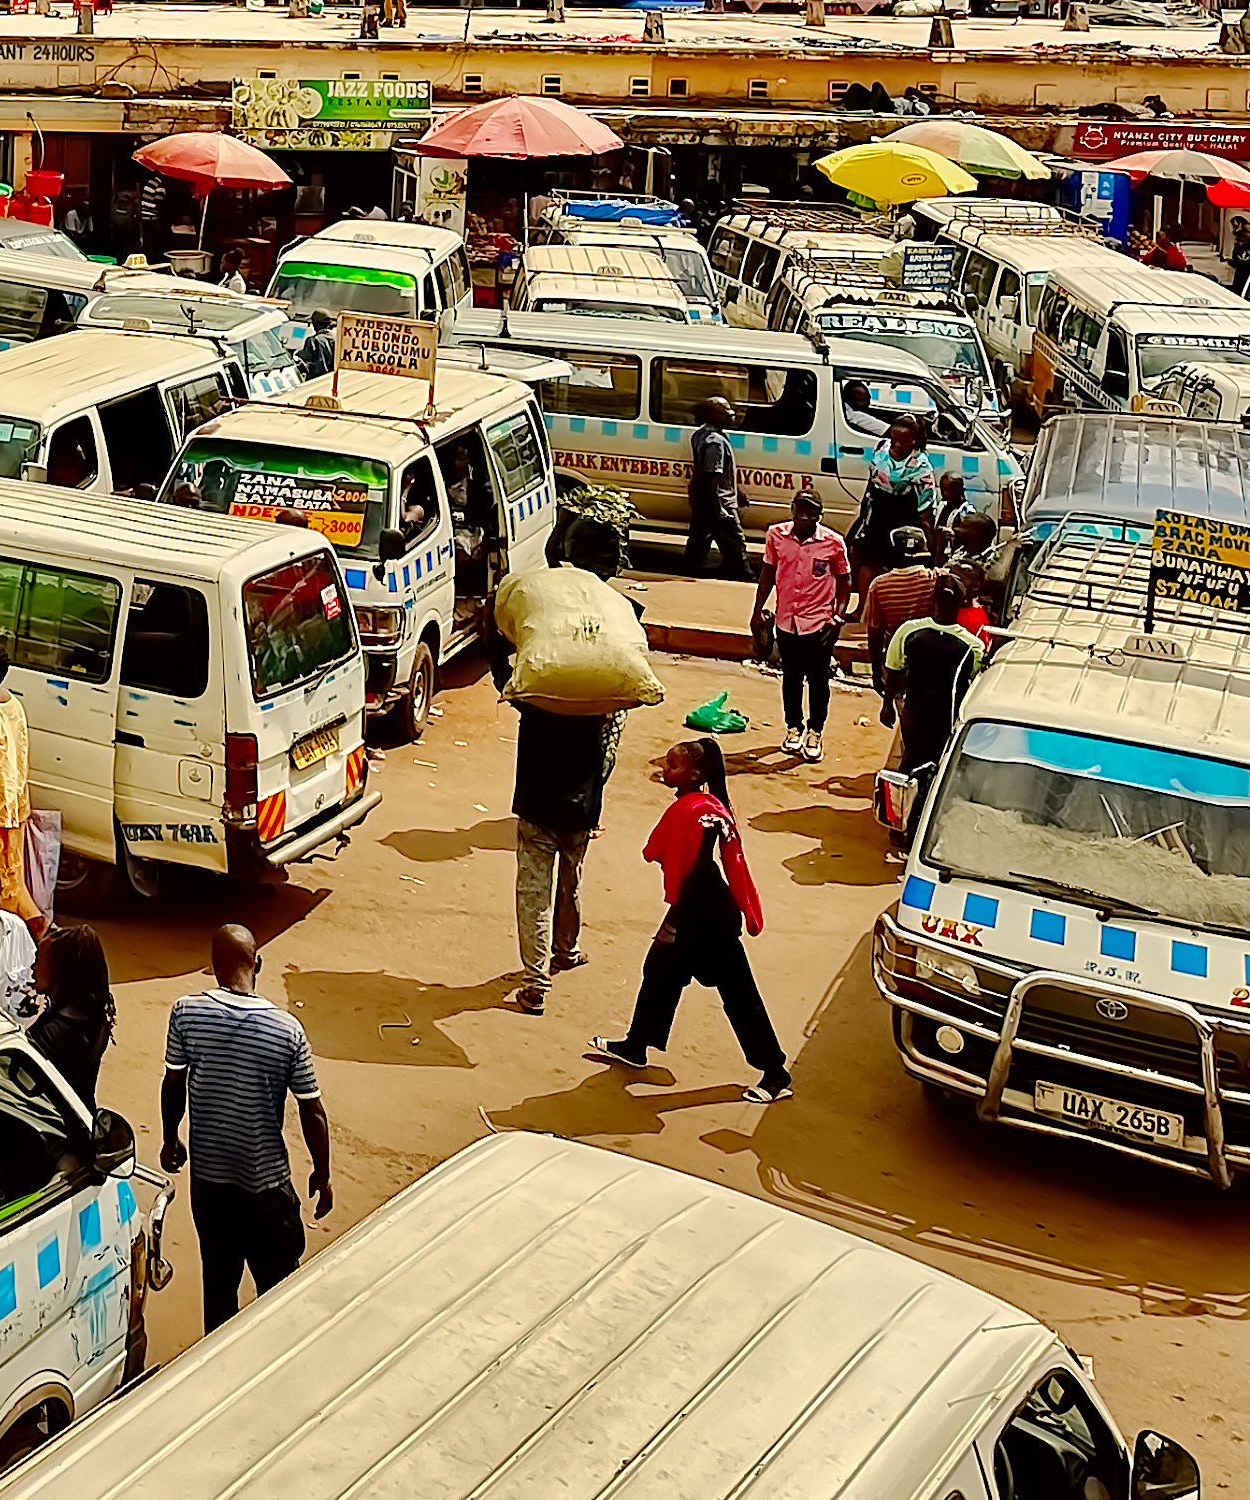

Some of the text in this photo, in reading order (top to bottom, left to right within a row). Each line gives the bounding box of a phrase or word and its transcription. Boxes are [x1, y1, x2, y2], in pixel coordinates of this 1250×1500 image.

[33, 46, 95, 62] 24HOURS
[327, 81, 429, 99] JAZZ FOODS
[329, 99, 424, 107] RESTAURANT
[1113, 131, 1247, 143] NYANZI CITY BUTCHERY
[883, 291, 907, 301] TAXI
[355, 319, 413, 335] NDEJJE
[821, 314, 962, 338] REALISM
[343, 326, 420, 346] KYADONDO
[341, 348, 418, 370] KAKOOLA
[1149, 403, 1177, 413] TAXI
[554, 450, 597, 470] PARK
[599, 455, 669, 477] ENTEBBE
[240, 473, 297, 488] ZANA
[233, 492, 332, 511] BATA-BATA
[337, 489, 368, 502] 2000
[329, 518, 362, 534] 3000
[1155, 525, 1205, 545] BRAC
[1161, 539, 1223, 561] ZANA
[1177, 571, 1240, 596] NFUFU
[1134, 638, 1176, 656] TAXI
[921, 913, 983, 947] UAX
[1062, 1091, 1104, 1123] UAX
[1116, 1105, 1170, 1137] 265B
